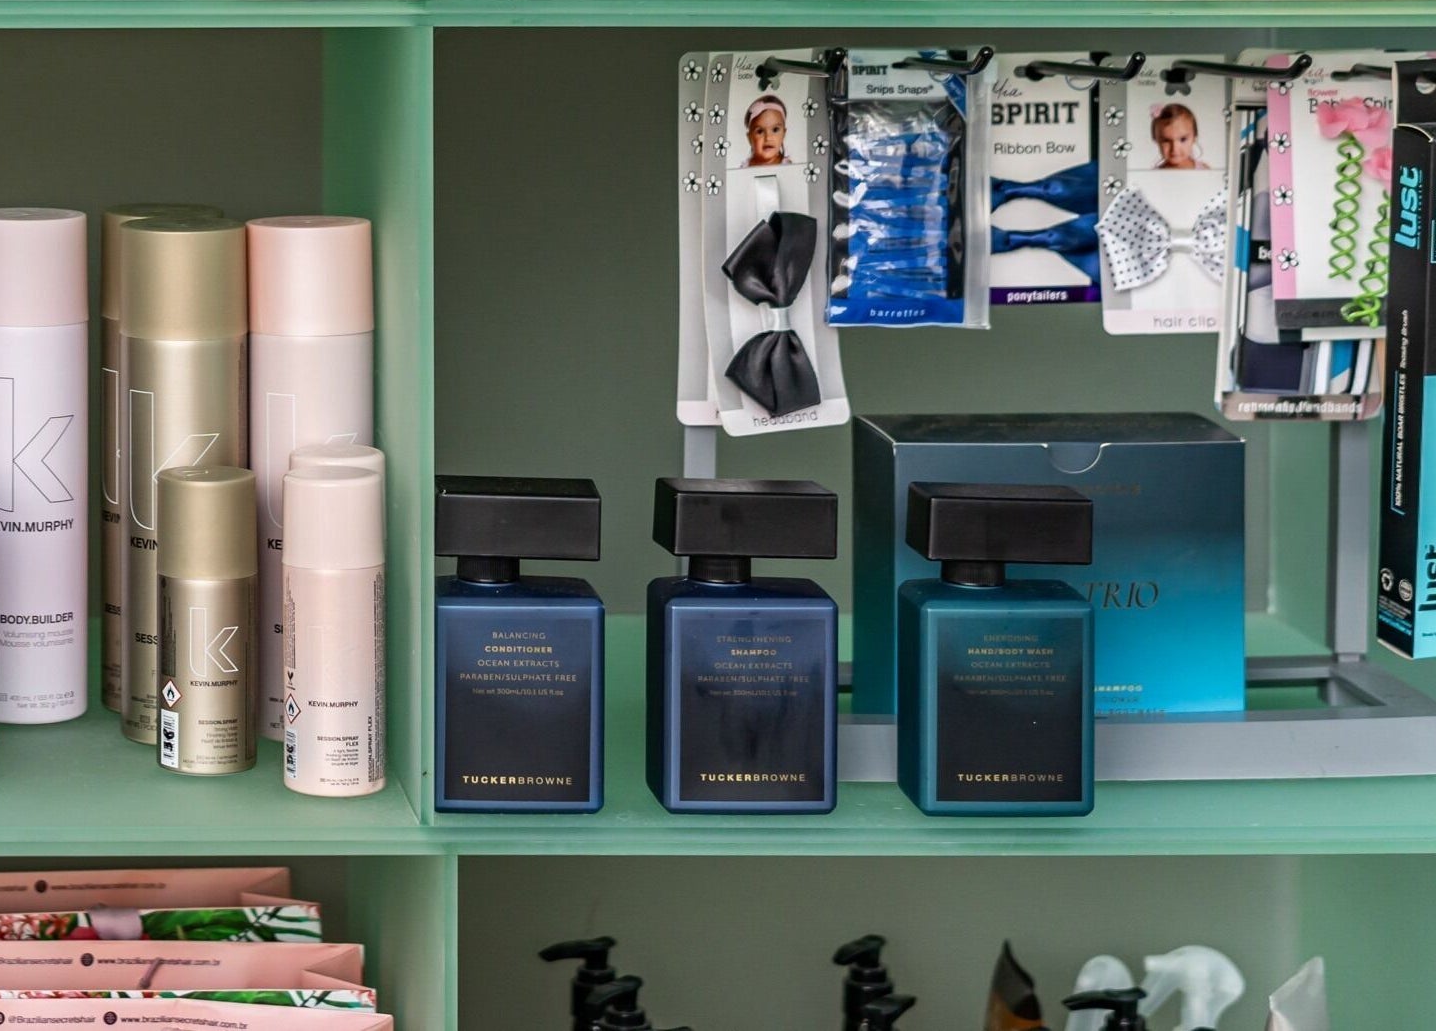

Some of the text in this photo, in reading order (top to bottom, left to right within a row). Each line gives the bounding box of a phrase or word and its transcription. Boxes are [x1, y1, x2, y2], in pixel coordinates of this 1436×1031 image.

[852, 65, 888, 76] SPIRIT
[866, 84, 897, 96] Snips
[991, 102, 1080, 125] SPIRIT
[994, 141, 1075, 155] Ribbon Bow
[1394, 166, 1419, 248] lust
[1007, 290, 1068, 303] ponytailers
[870, 307, 926, 317] barrettes
[1154, 314, 1217, 329] hair clip
[1085, 581, 1159, 608] TRIO
[0, 612, 74, 625] BODY.BUILDER
[492, 632, 546, 640] BALANCING
[485, 645, 553, 654] CONDITIONER
[477, 659, 560, 667] OCEAN EXTRACTS
[460, 673, 577, 682] PARABEN/SULPHATE FREE
[308, 700, 359, 708] KEVIN.MURPHY
[463, 775, 573, 785] TUCKERBROWNE
[700, 773, 806, 782] TUCKERBROWNE
[957, 773, 1063, 782] TUCKERBROWNE
[8, 1015, 96, 1024] @Braziliansecretshair
[120, 1016, 248, 1030] www.braziliansecretshair.com.br
